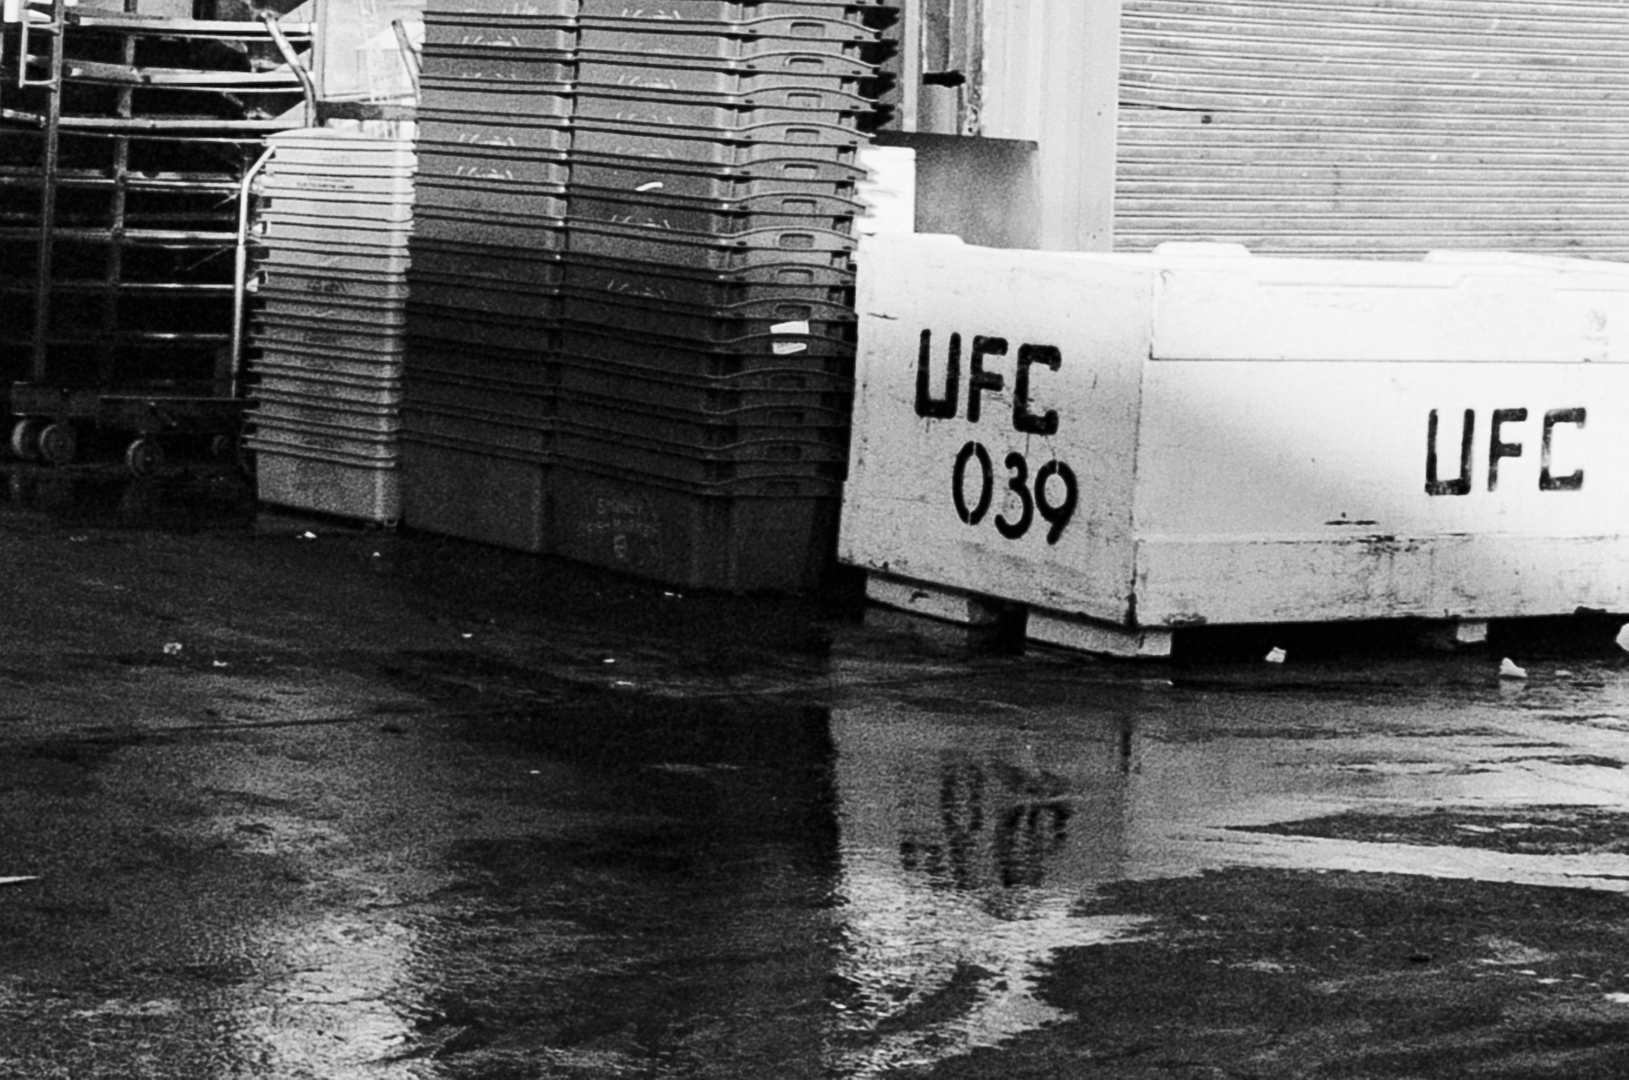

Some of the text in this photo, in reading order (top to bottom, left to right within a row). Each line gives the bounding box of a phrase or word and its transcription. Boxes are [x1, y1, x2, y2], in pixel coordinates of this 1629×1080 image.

[914, 328, 1062, 435] UFC
[952, 440, 1079, 545] 039
[1424, 407, 1586, 496] UFC
